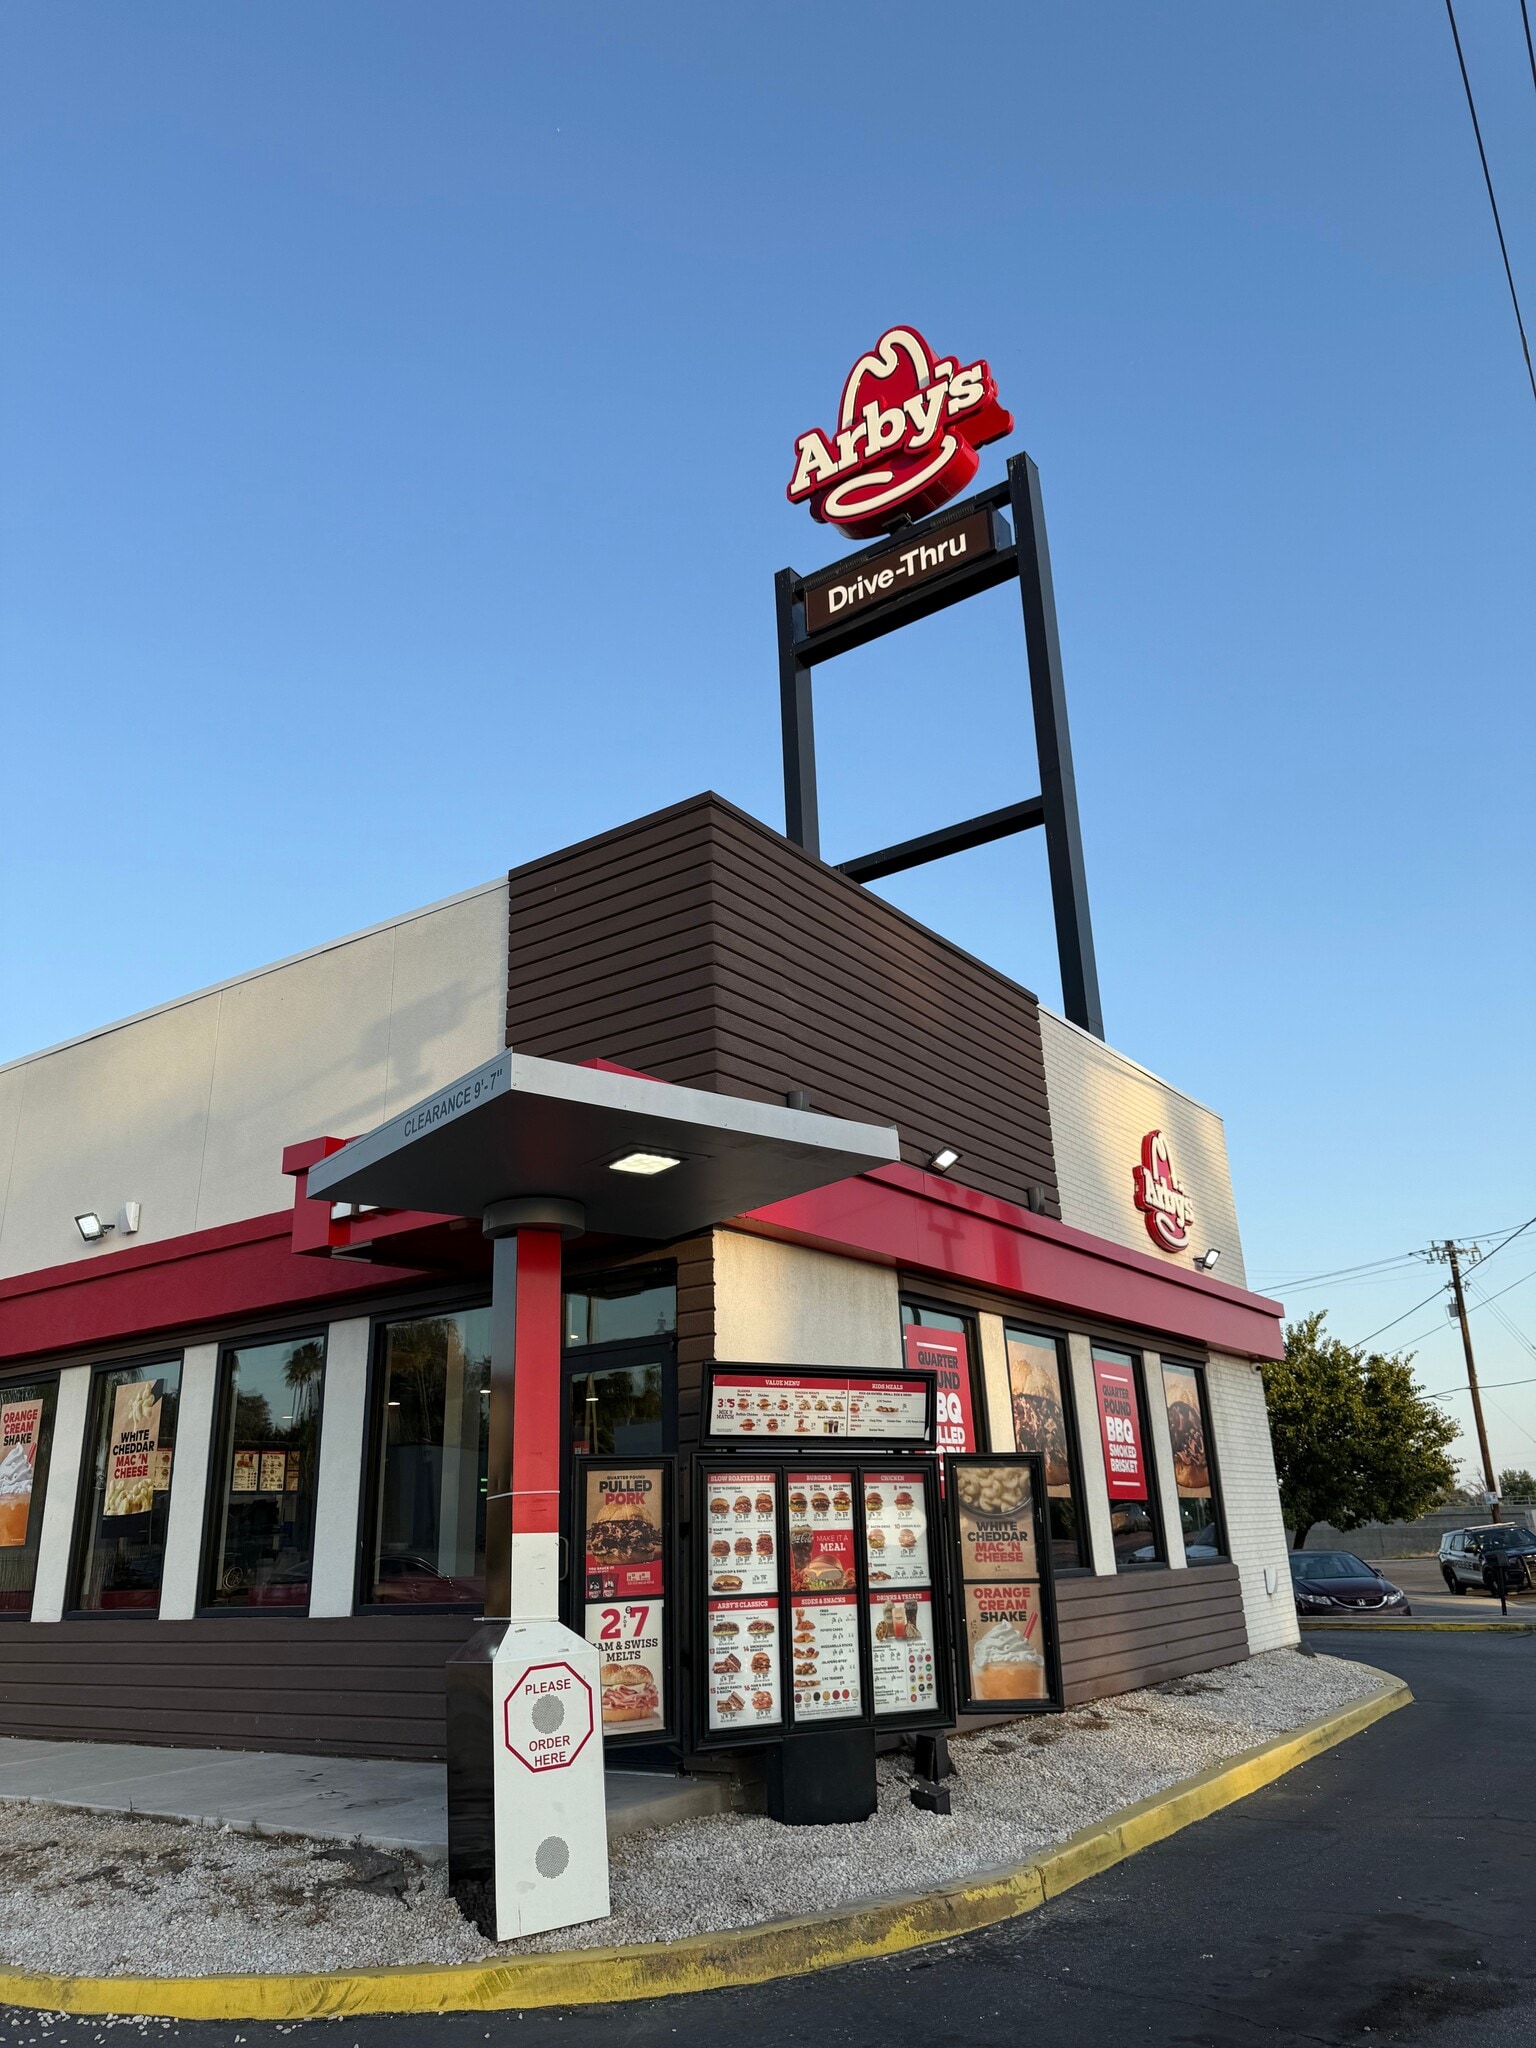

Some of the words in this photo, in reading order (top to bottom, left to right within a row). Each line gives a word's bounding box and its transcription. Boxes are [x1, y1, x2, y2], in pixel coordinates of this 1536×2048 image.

[790, 360, 984, 495] Arby's
[828, 532, 967, 614] Drive-Thru
[404, 1086, 471, 1137] CLEARANCE
[918, 1351, 958, 1369] QUARTER
[937, 1370, 960, 1390] UND
[1102, 1384, 1129, 1399] QUARTER
[937, 1391, 963, 1424] BQ
[1104, 1398, 1132, 1416] POUND
[3, 1408, 38, 1424] ORANGE
[4, 1421, 34, 1435] CREAM
[1105, 1416, 1135, 1444] BBQ
[4, 1432, 32, 1446] SHAKE
[120, 1429, 150, 1443] WHITE
[112, 1441, 154, 1456] CHEDDAR
[1109, 1443, 1136, 1459] SMOKED
[116, 1455, 136, 1468] MAC
[1110, 1458, 1138, 1474] BRISKET
[114, 1465, 148, 1480] CHEESE
[599, 1480, 652, 1493] PULLED
[605, 1493, 646, 1505] PORK
[976, 1521, 1018, 1532] WHITE
[968, 1532, 1028, 1542] CHEDDAR
[820, 1543, 846, 1552] MEAL
[976, 1542, 1005, 1552] MAC
[975, 1552, 1024, 1563] CHEESE
[973, 1587, 1031, 1599] ORANGE
[978, 1600, 1027, 1611] CREAM
[600, 1608, 621, 1640] 2
[981, 1611, 1027, 1622] SHAKE
[593, 1641, 614, 1651] AM
[616, 1641, 622, 1650] &
[624, 1638, 658, 1650] SWISS
[606, 1650, 641, 1662] MELTS
[525, 1678, 571, 1695] PLEASE
[529, 1735, 571, 1751] ORDER
[534, 1751, 566, 1767] HERE
